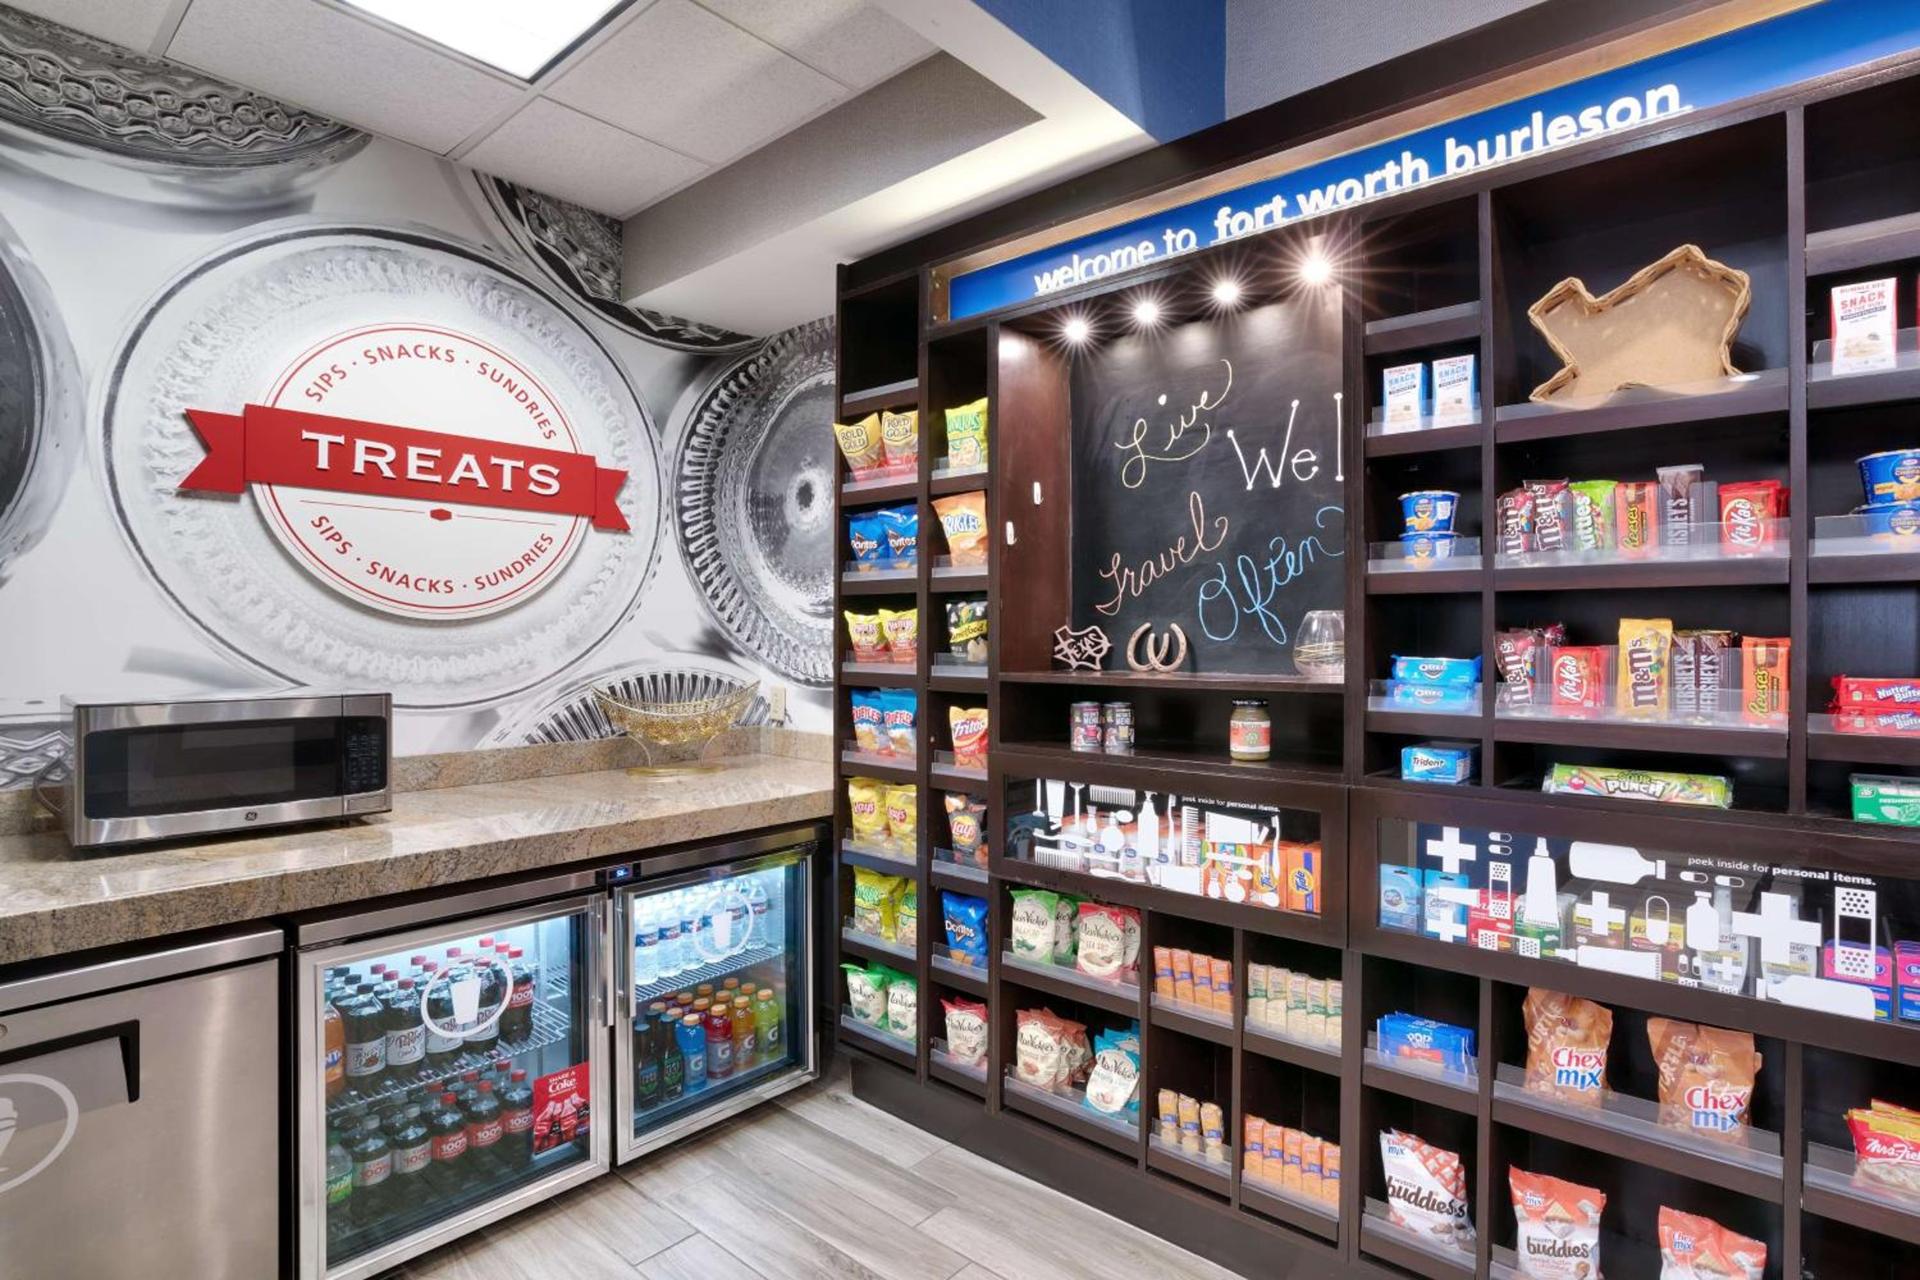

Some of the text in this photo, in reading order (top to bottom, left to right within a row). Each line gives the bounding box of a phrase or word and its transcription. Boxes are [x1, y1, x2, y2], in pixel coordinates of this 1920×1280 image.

[1034, 82, 1681, 293] welcome to fort worth burleson
[1841, 291, 1886, 310] SNACK
[305, 343, 557, 441] SIPS SNACKS SUNDRIES
[1115, 359, 1232, 488] Live
[302, 428, 561, 496] TREATS
[310, 514, 554, 594] SIPS SNACKS SUNDRIES
[1095, 491, 1344, 645] Travel Often
[1876, 685, 1911, 700] Nutter
[952, 718, 985, 738] Fritos
[1878, 713, 1912, 727] Nutter
[1413, 757, 1445, 768] Trident
[1605, 779, 1665, 799] PUNCH
[1226, 800, 1257, 810] personal
[1687, 856, 1877, 886] peek inside for personal items.
[944, 920, 975, 937] Doritos
[743, 1034, 756, 1049] G
[768, 1026, 779, 1042] G
[718, 1044, 731, 1061] G
[1553, 1048, 1604, 1069] Chex
[690, 1055, 704, 1071] G
[548, 1078, 578, 1094] Coke
[1556, 1068, 1601, 1090] mix
[1685, 1087, 1748, 1111] Chex
[1693, 1110, 1741, 1131] mix
[1387, 1175, 1454, 1216] buddies
[1527, 1235, 1589, 1258] buddies
